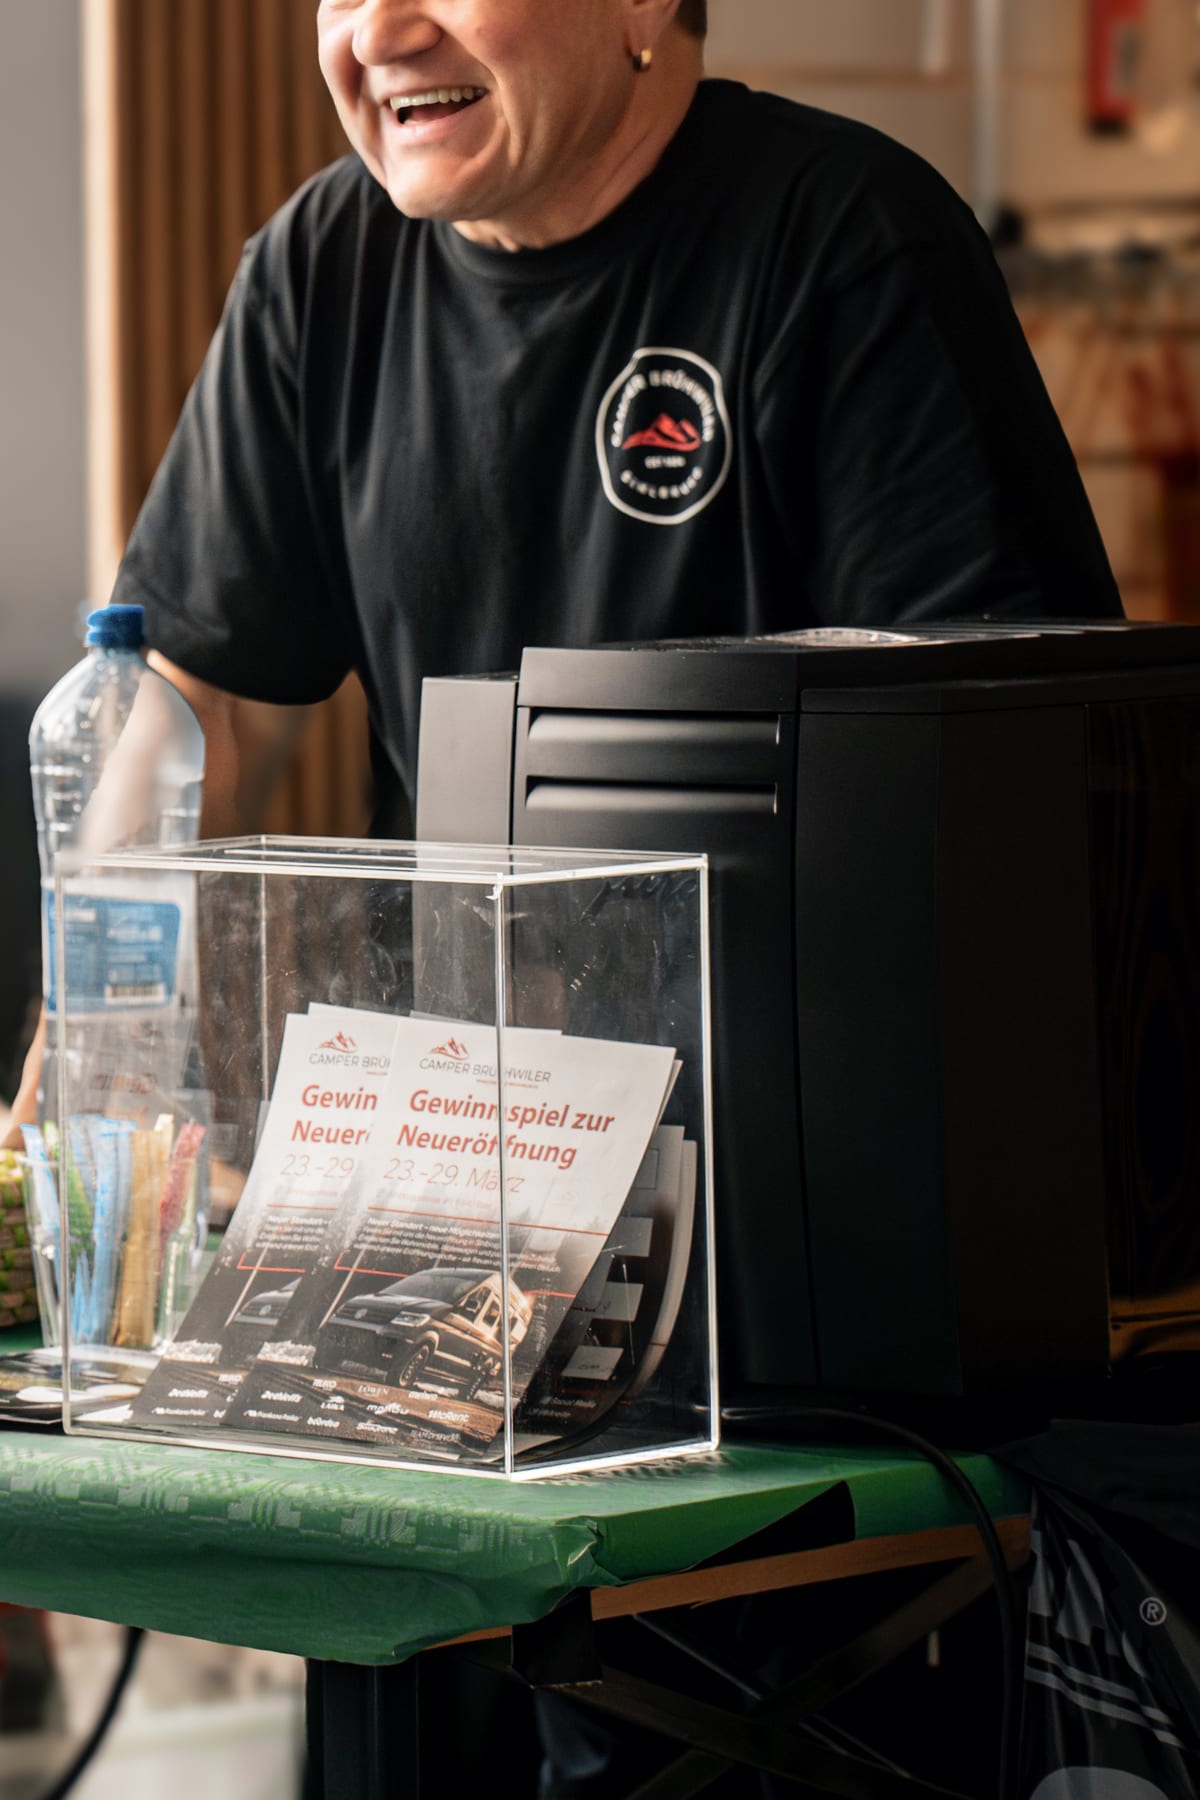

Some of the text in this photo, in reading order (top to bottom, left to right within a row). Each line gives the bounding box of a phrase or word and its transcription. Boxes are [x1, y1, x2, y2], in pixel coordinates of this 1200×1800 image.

[308, 1052, 359, 1067] CAMPER
[418, 1057, 471, 1075] CAMPER
[291, 1119, 371, 1146] Neuer
[571, 1111, 616, 1133] zur
[465, 1166, 526, 1194] Mäz
